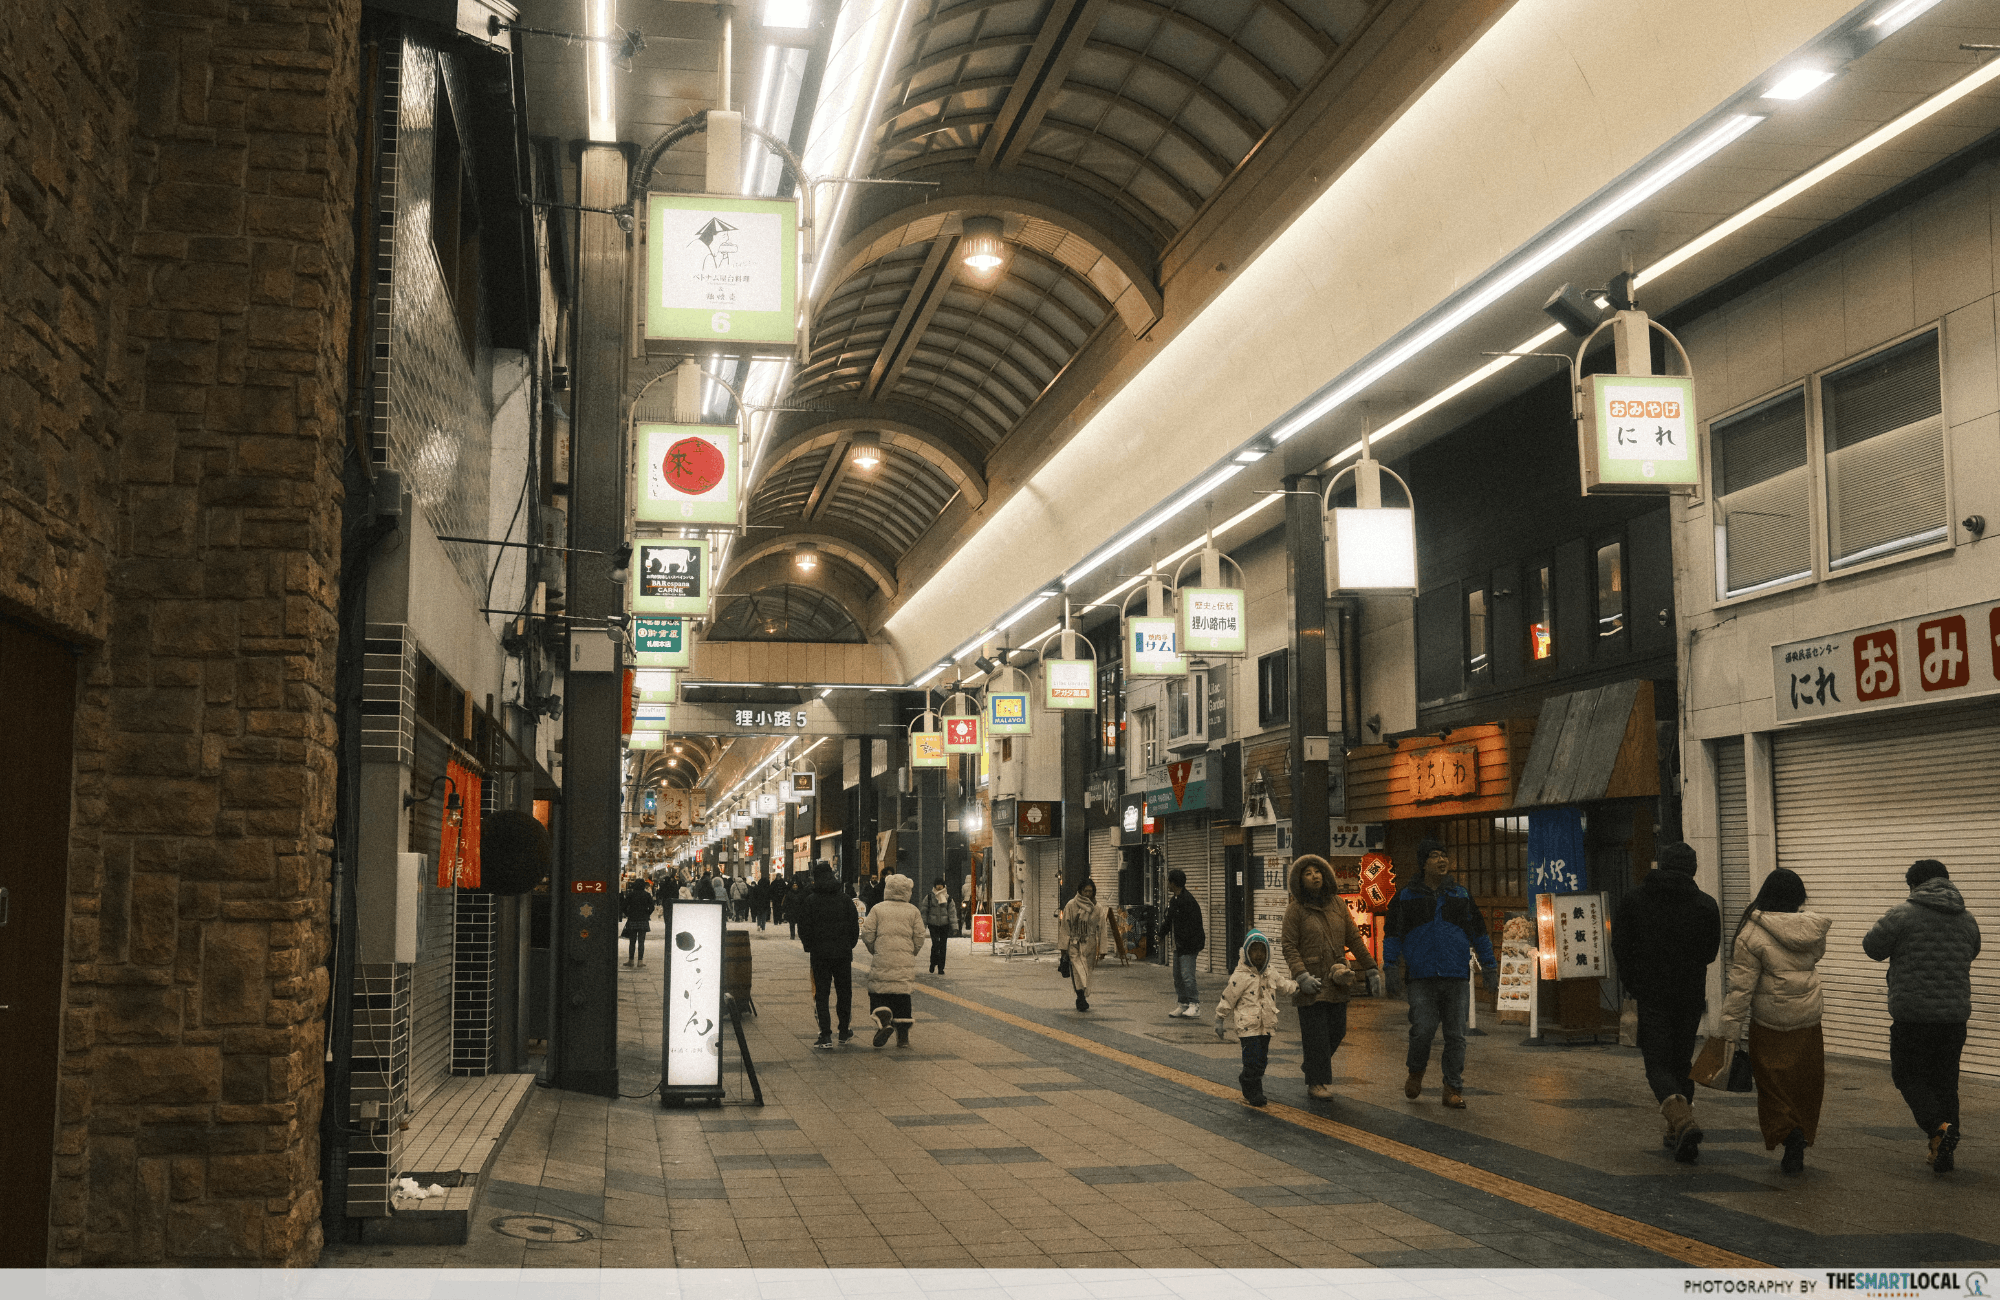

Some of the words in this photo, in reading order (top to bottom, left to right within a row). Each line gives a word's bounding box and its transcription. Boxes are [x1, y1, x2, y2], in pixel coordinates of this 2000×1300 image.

[711, 311, 731, 334] 6
[1610, 401, 1680, 418] おみやげ
[1617, 425, 1677, 447] にれ
[1641, 460, 1655, 478] 6
[681, 501, 694, 517] 6
[1195, 602, 1234, 610] 歴史と伝統
[1192, 615, 1237, 631] 狸小路市場
[1145, 641, 1172, 652] サム
[1860, 625, 2000, 694] おみ
[1208, 682, 1220, 696] Lilac
[1791, 666, 1841, 710] にれ
[1208, 698, 1226, 712] Garden
[736, 710, 791, 727] 狸小路
[796, 711, 808, 728] 5
[1332, 834, 1365, 848] サム
[1572, 906, 1588, 966] 鉄板焼
